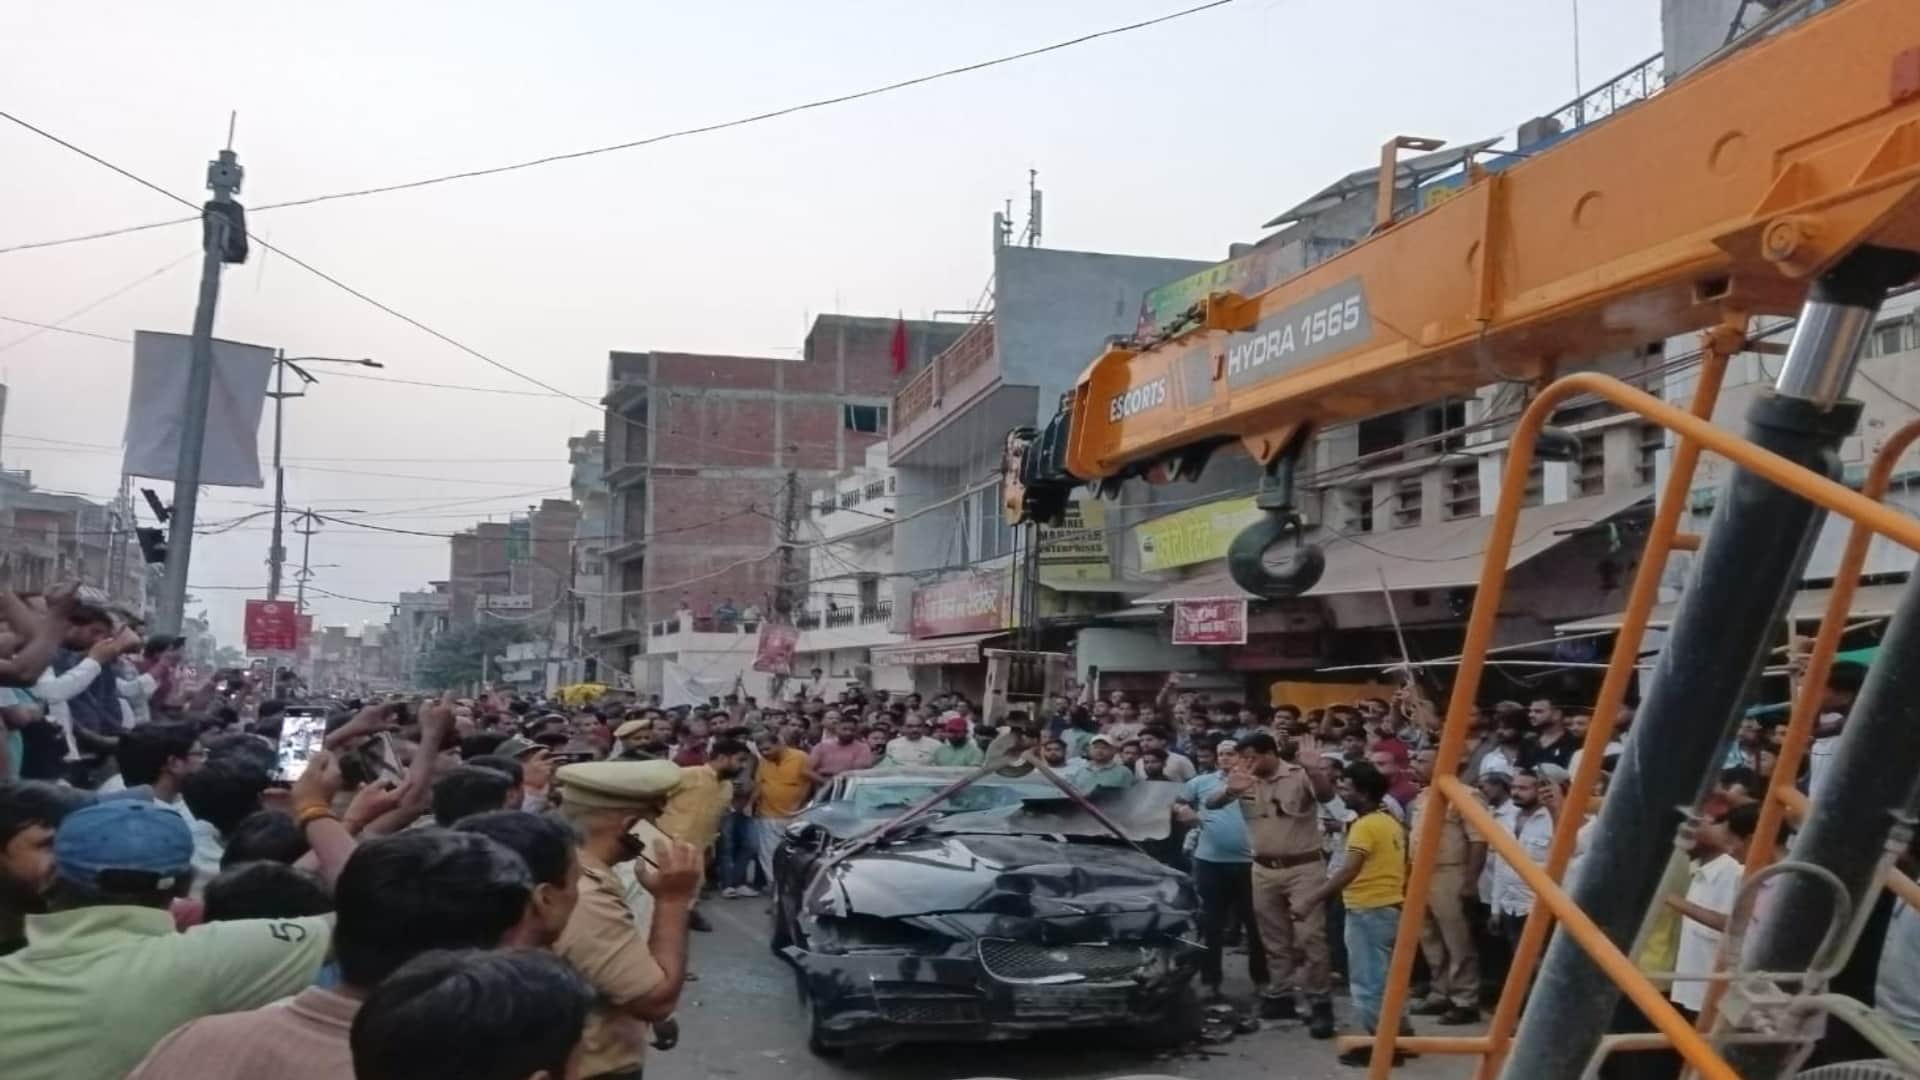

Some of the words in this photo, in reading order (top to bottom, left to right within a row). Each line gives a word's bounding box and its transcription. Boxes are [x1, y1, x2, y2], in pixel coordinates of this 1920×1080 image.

[1227, 324, 1296, 377] HYDRA
[1300, 295, 1361, 347] 1565
[1109, 377, 1167, 424] ESCORTS
[269, 922, 306, 942] 5
